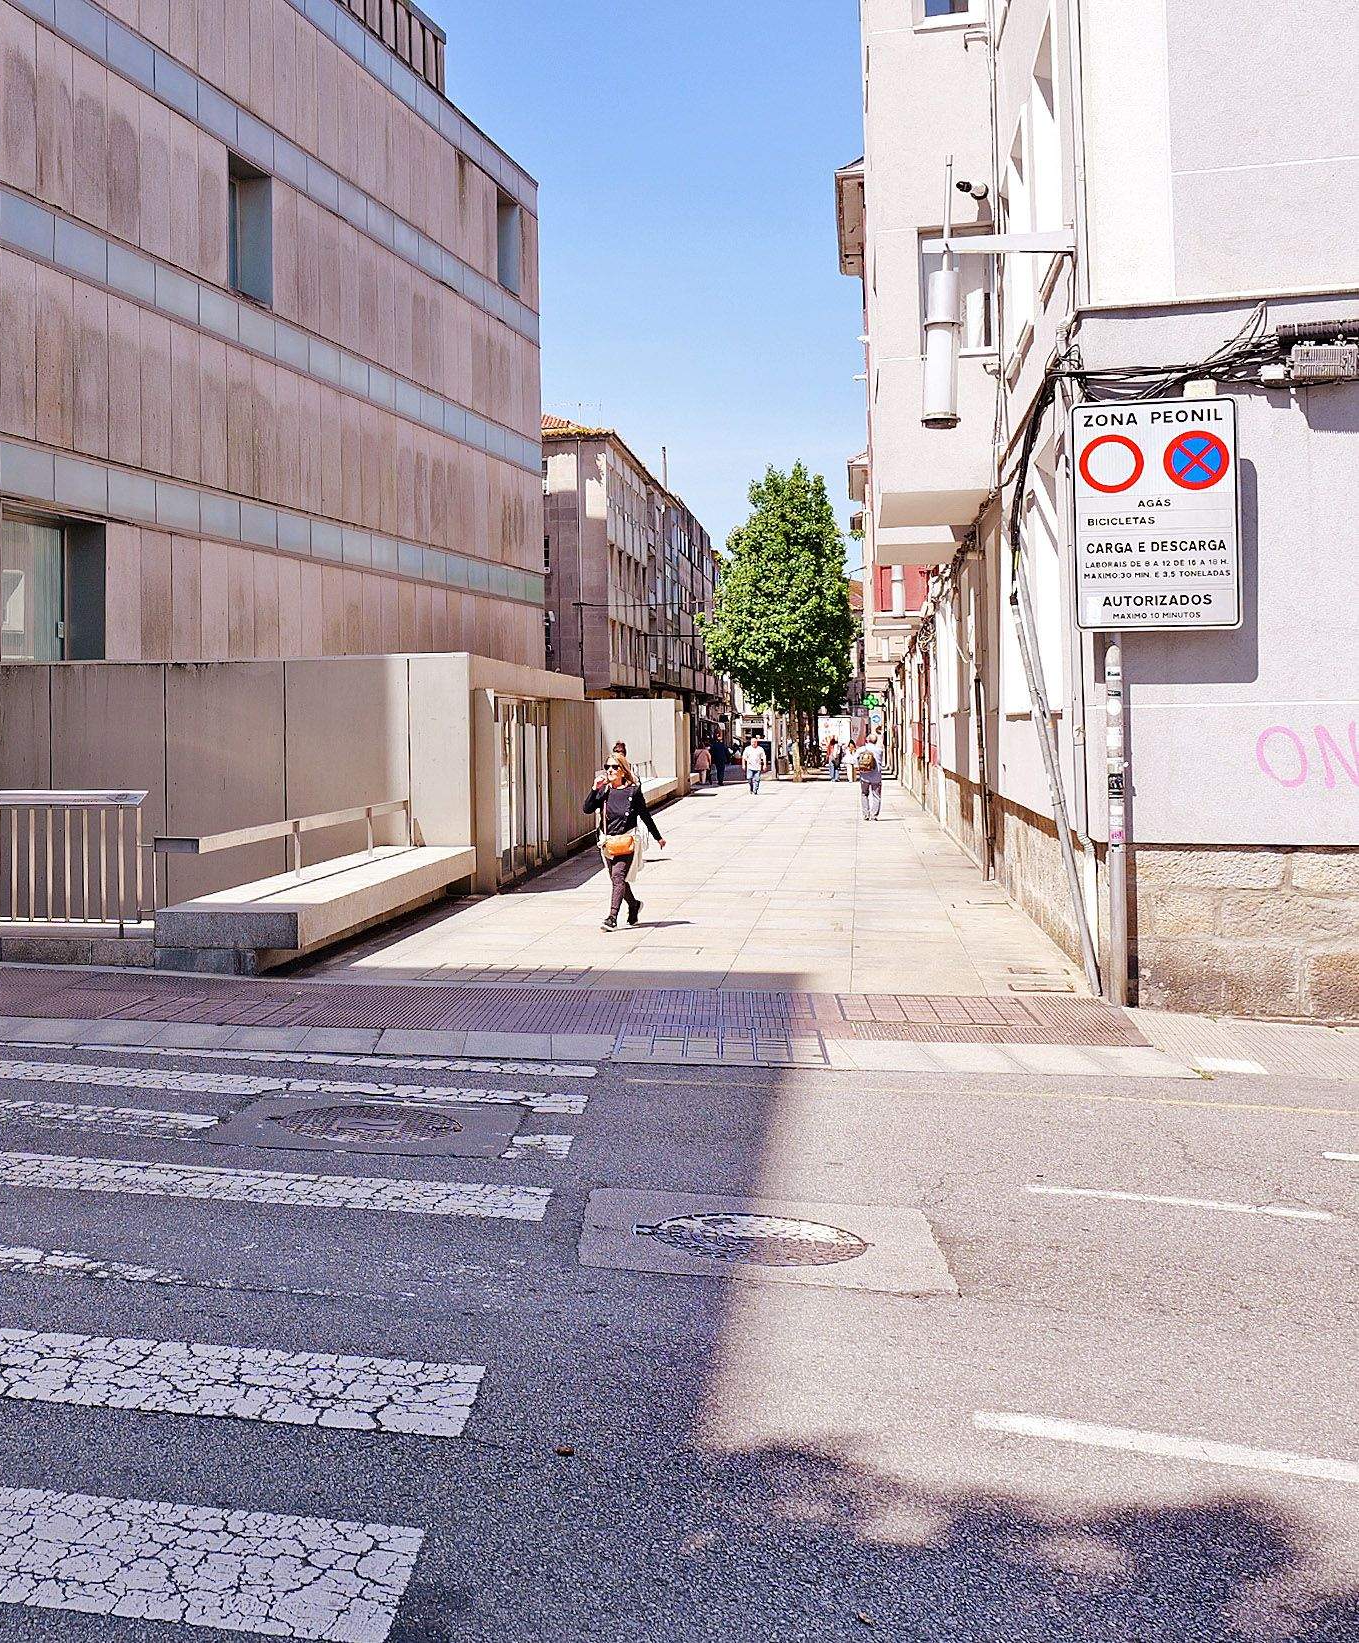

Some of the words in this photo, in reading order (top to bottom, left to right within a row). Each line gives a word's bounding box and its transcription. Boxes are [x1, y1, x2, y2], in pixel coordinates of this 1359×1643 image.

[1083, 412, 1138, 428] ZONA
[1150, 408, 1223, 424] PEONIL
[1087, 516, 1155, 526] BICICLETAS
[1087, 543, 1133, 554] CARGA
[1139, 542, 1145, 552] E
[1151, 539, 1227, 552] DESCARGA
[1103, 594, 1212, 607] AUTORIZADOS
